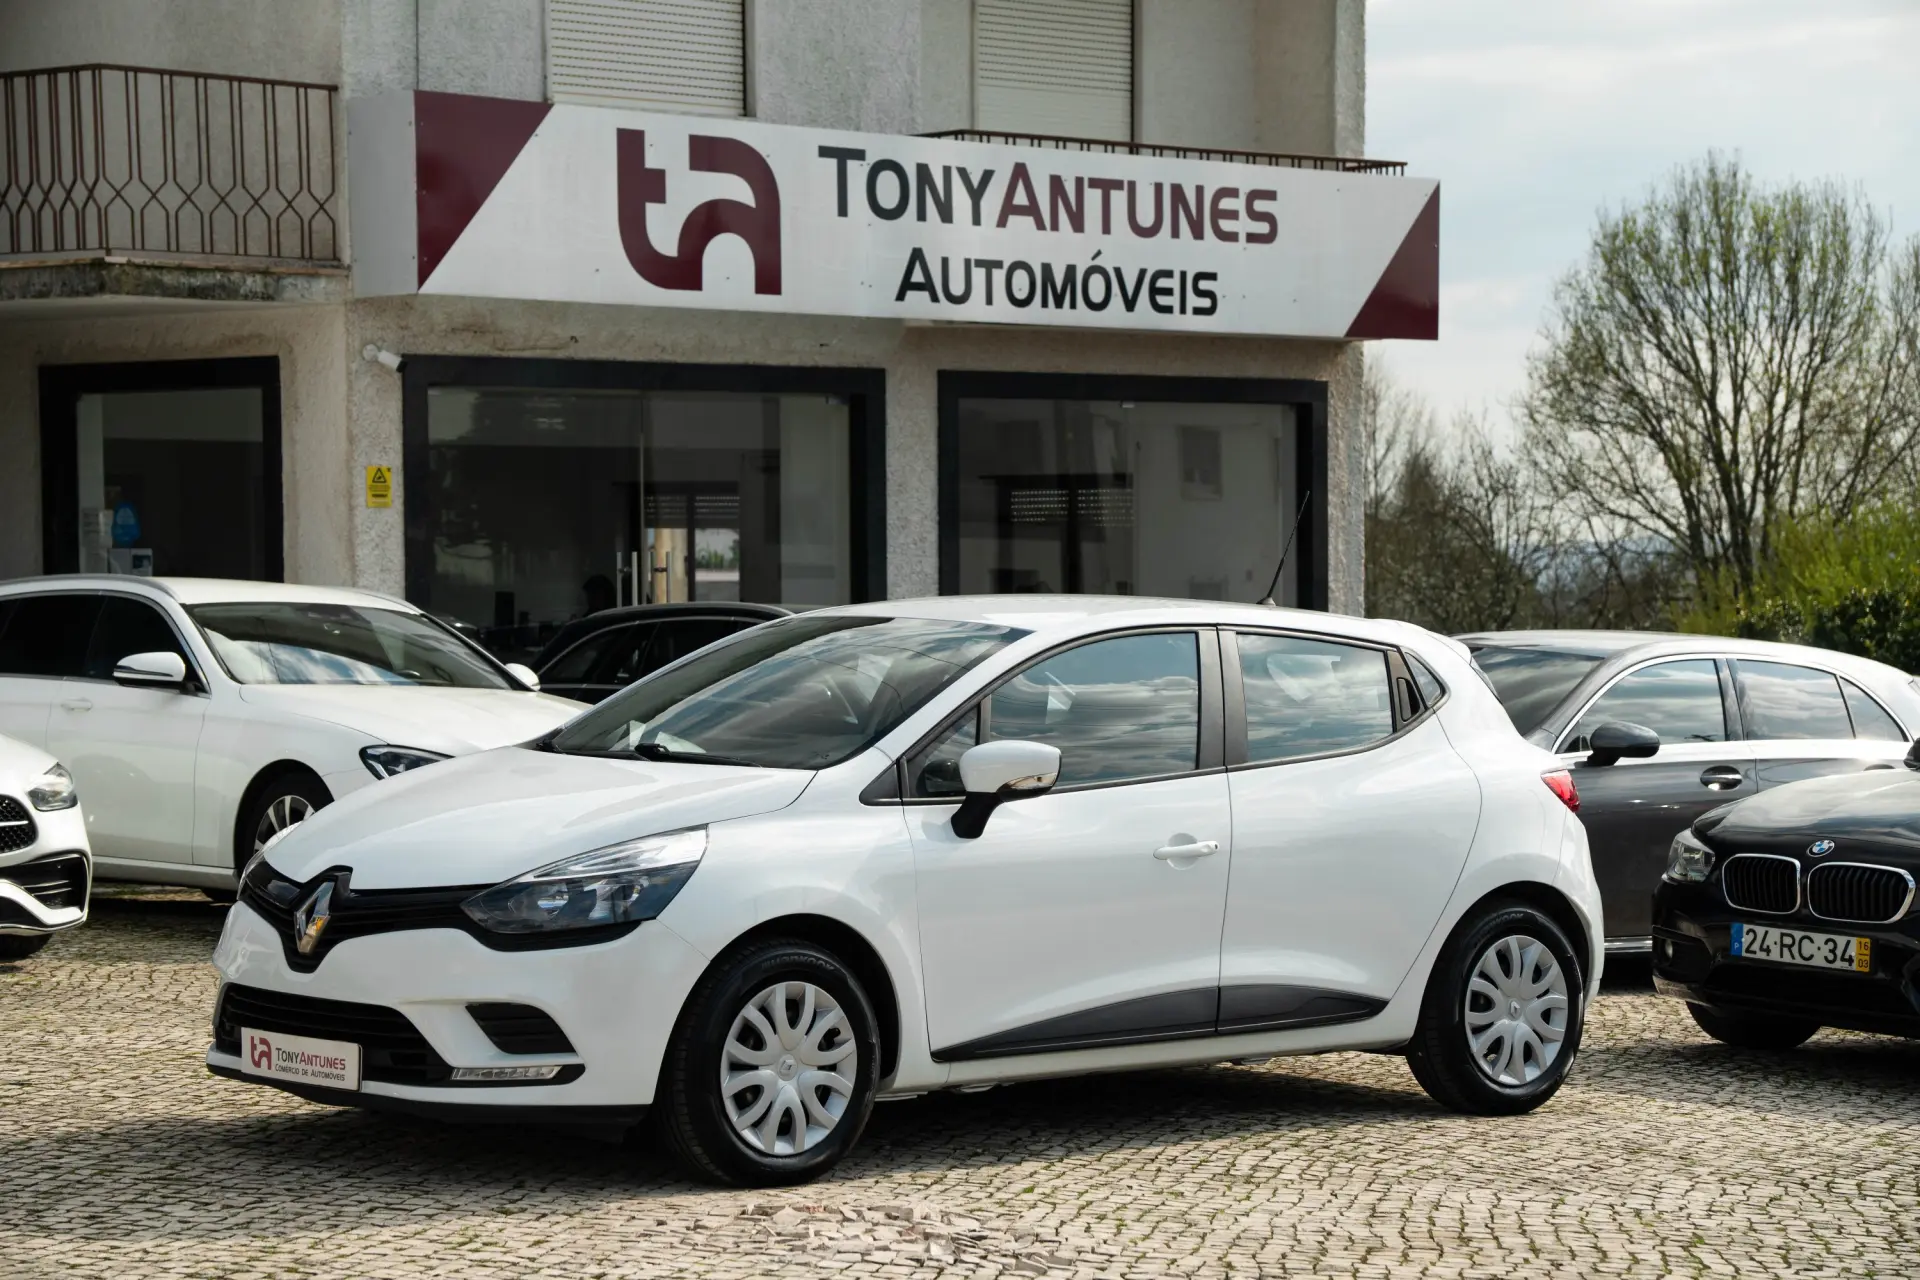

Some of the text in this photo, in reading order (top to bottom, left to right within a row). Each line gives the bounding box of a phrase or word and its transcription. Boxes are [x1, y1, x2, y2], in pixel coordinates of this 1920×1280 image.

[894, 246, 1219, 317] AUTOMÓVEIS
[1858, 940, 1869, 951] 16
[1857, 958, 1869, 969] 03
[301, 1068, 309, 1076] DE
